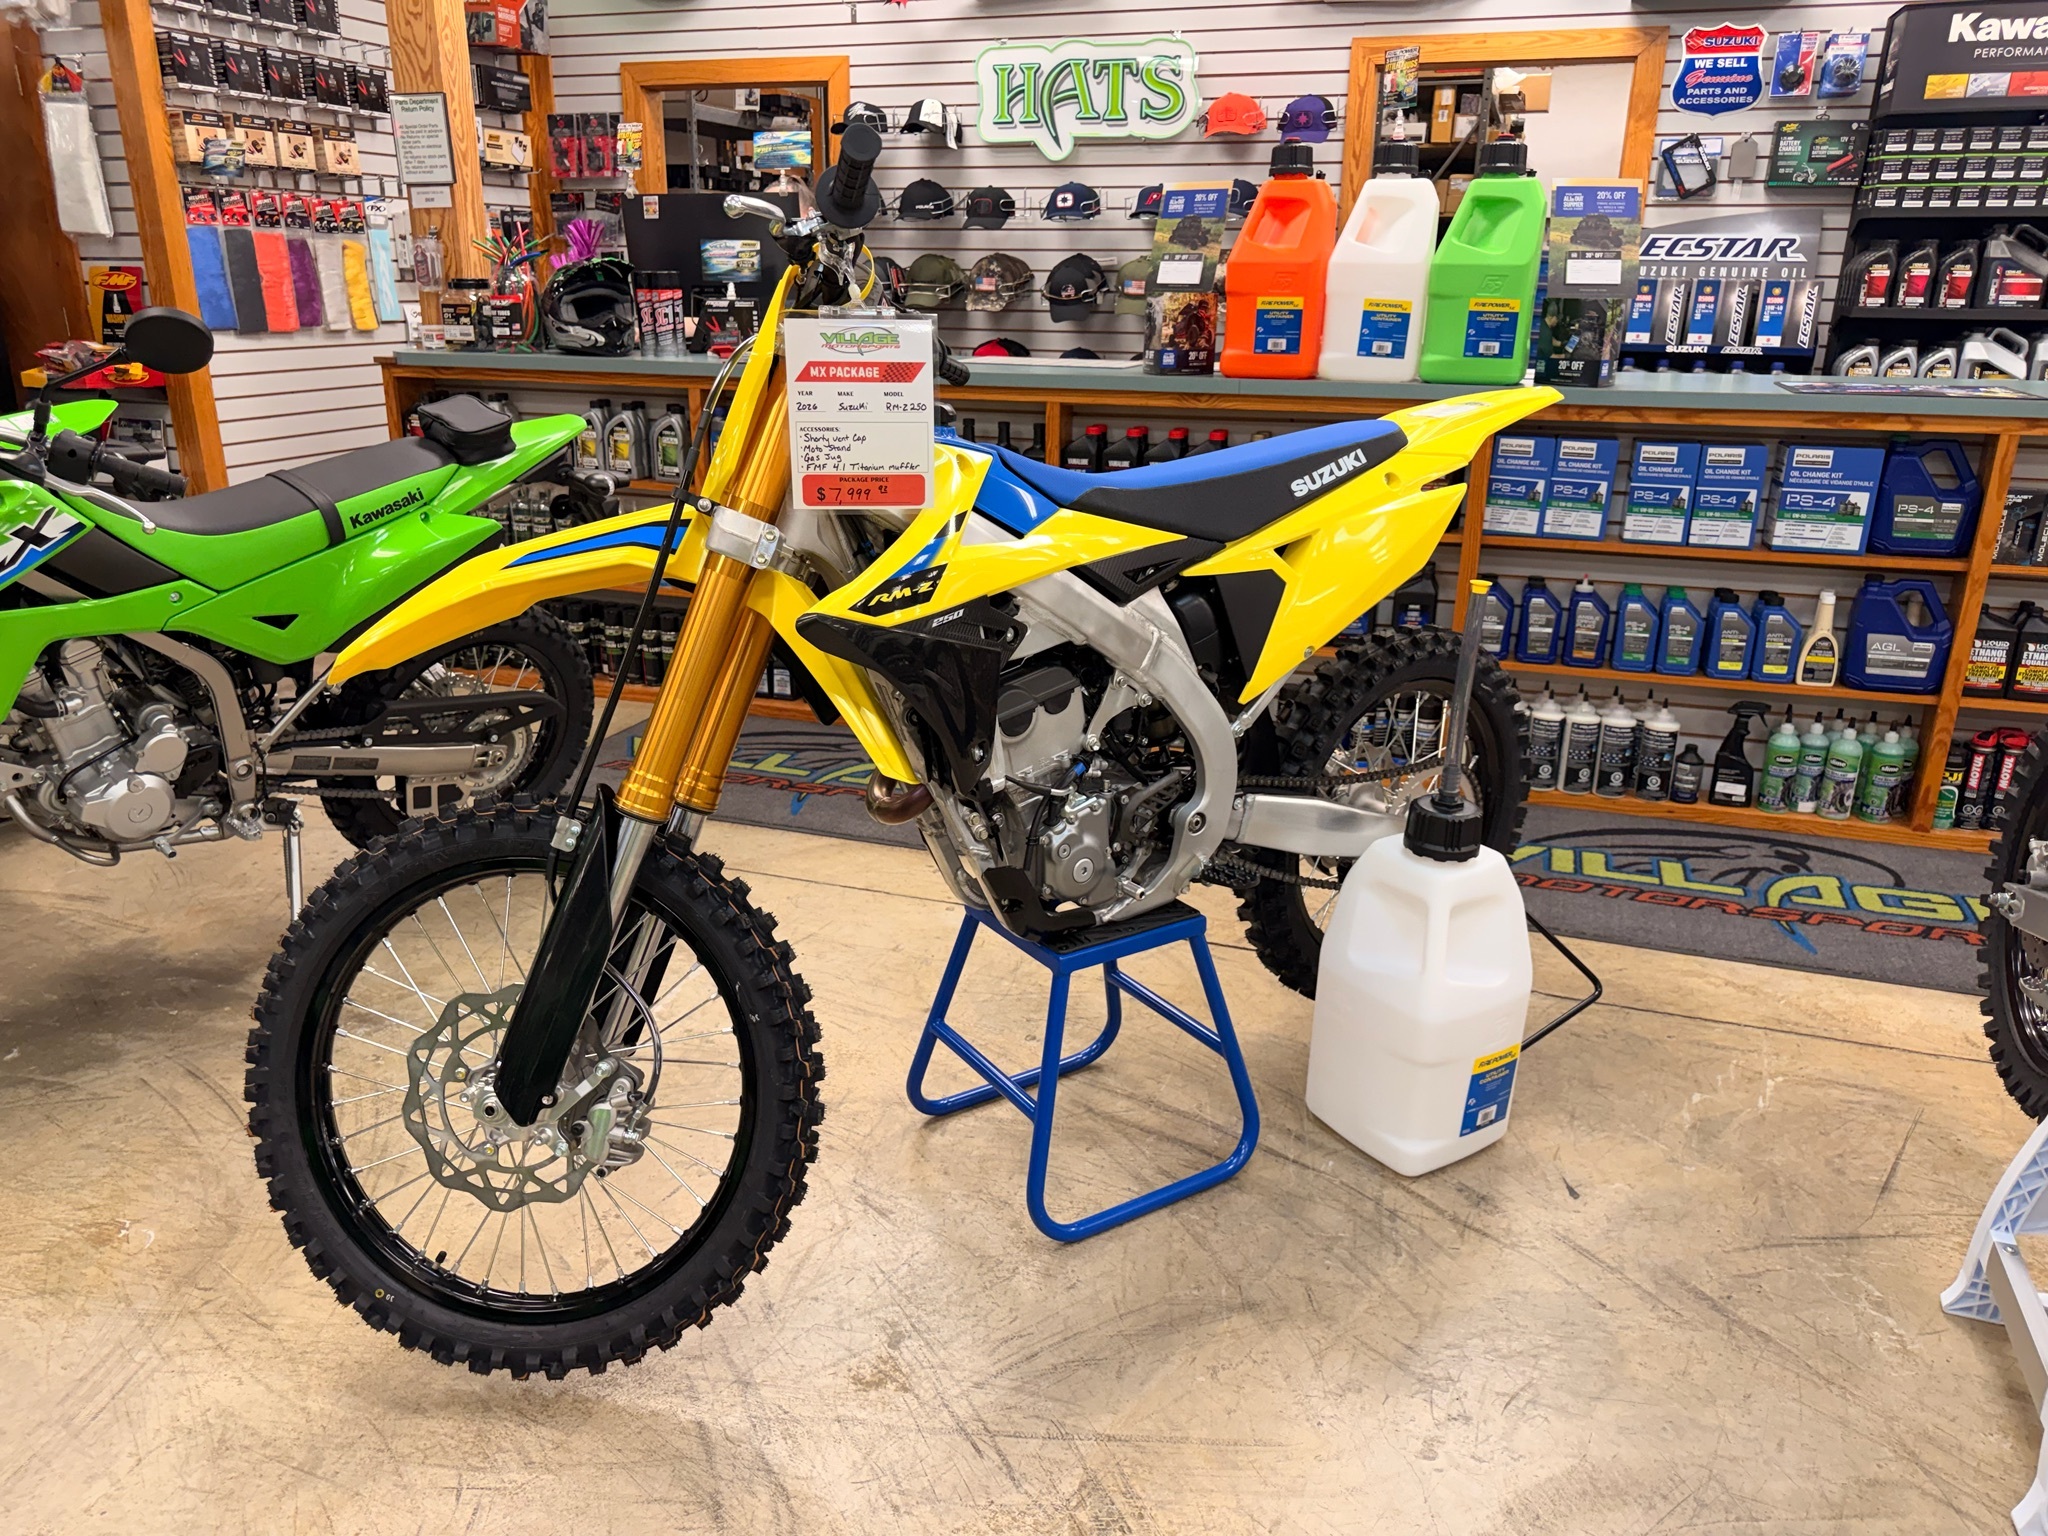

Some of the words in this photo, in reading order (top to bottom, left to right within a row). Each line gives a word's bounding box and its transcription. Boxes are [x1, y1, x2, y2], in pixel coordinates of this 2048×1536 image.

[1704, 36, 1760, 46] SUZUKI
[1694, 59, 1714, 68] WE
[1717, 58, 1748, 68] SELL
[1685, 69, 1753, 88] Genuine
[409, 98, 438, 106] Department
[993, 55, 1185, 151] HATS
[1678, 96, 1754, 104] ACCESSORIES
[1698, 146, 1712, 172] SUZUKI
[1597, 191, 1612, 200] 20%
[1639, 234, 1807, 262] ECSTAR
[1640, 266, 1687, 277] UZUKI
[1699, 266, 1769, 278] GENUINE
[1781, 267, 1807, 278] OIL
[93, 275, 137, 286] FMF
[656, 304, 674, 327] SC1
[1665, 284, 1684, 346] ECSTAR
[1728, 284, 1749, 346] ECSTAR
[1798, 285, 1819, 348] ECSTAR
[820, 332, 900, 346] VILLAGE
[1665, 345, 1708, 353] SUZUKI
[1199, 351, 1207, 360] OFF
[1558, 361, 1570, 369] 20%
[1571, 362, 1585, 370] OFF
[810, 367, 826, 377] MX
[830, 367, 879, 378] PACKAGE
[796, 402, 818, 410] 2026
[804, 433, 830, 446] Shorty
[804, 453, 820, 462] Gas
[824, 454, 842, 462] Jug
[850, 463, 884, 471] Titanium
[1291, 448, 1367, 497] SUZUKI
[1492, 482, 1526, 493] PS-4
[1553, 485, 1588, 495] PS-4
[1634, 490, 1669, 500] PS-4
[1700, 494, 1736, 504] PS-4
[1786, 494, 1836, 507] PS-4
[350, 488, 424, 529] Kawasaki
[1898, 504, 1934, 514] PS-4
[868, 581, 934, 606] RM-Z
[932, 608, 964, 628] 250
[1870, 642, 1901, 652] AGL
[1831, 759, 1846, 768] slime
[1969, 755, 1982, 788] MOTUL
[2000, 755, 2014, 789] MOTUL
[1479, 1070, 1510, 1084] CONTAINER
